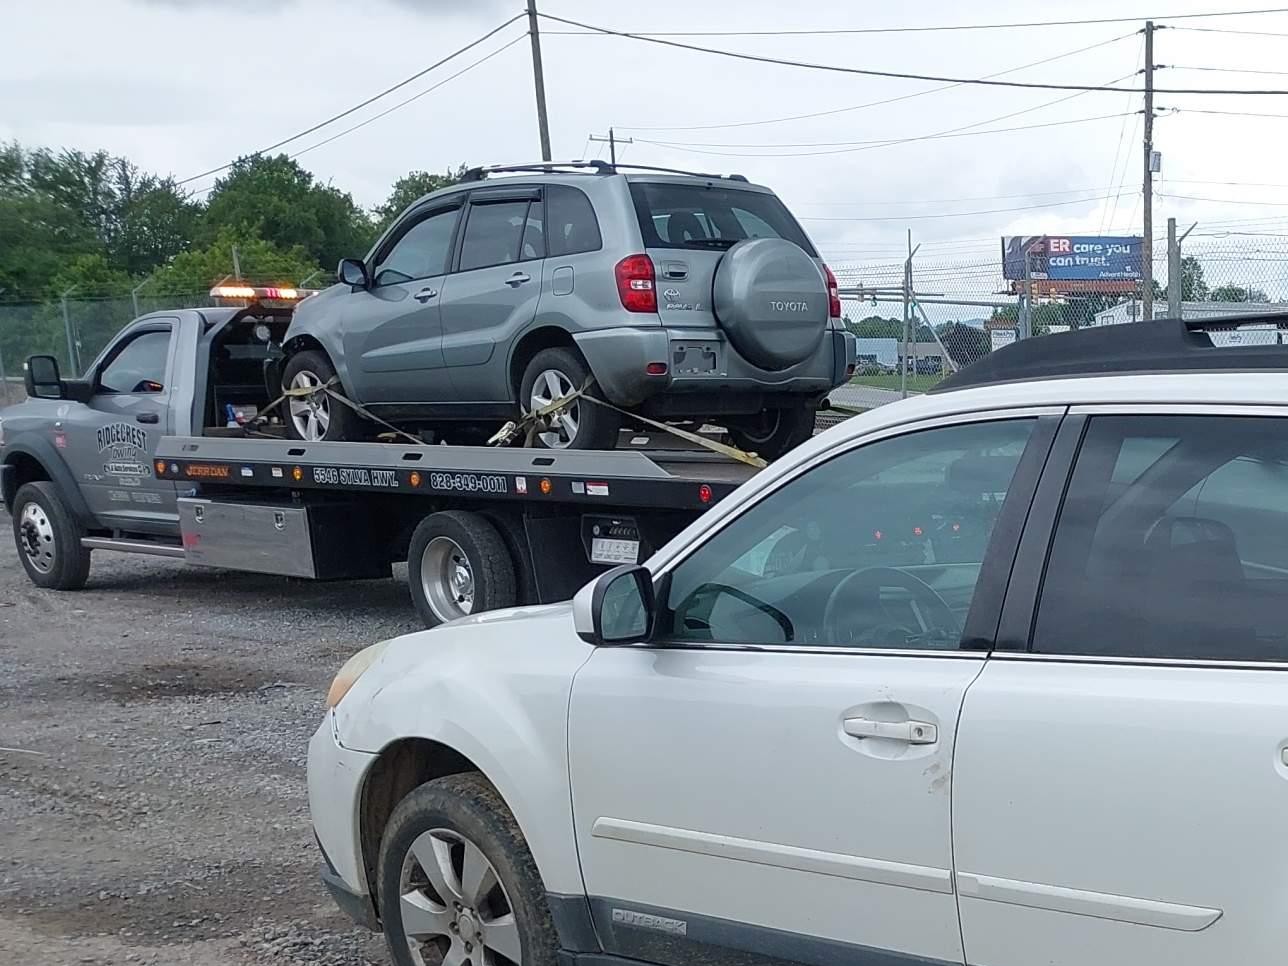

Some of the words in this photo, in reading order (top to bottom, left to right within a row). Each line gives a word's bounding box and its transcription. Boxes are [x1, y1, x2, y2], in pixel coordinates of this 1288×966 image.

[1049, 238, 1071, 252] ER
[1073, 243, 1103, 254] care
[1106, 244, 1131, 256] you
[1049, 256, 1073, 267] can
[1075, 255, 1110, 267] trust.
[770, 301, 809, 312] TOYOTA
[96, 422, 149, 454] RIDGECREST
[110, 444, 137, 462] Towing
[313, 467, 338, 484] 5546
[340, 468, 370, 486] SYLVA
[371, 470, 399, 487] HWY.
[430, 472, 508, 493] 828-349-0011
